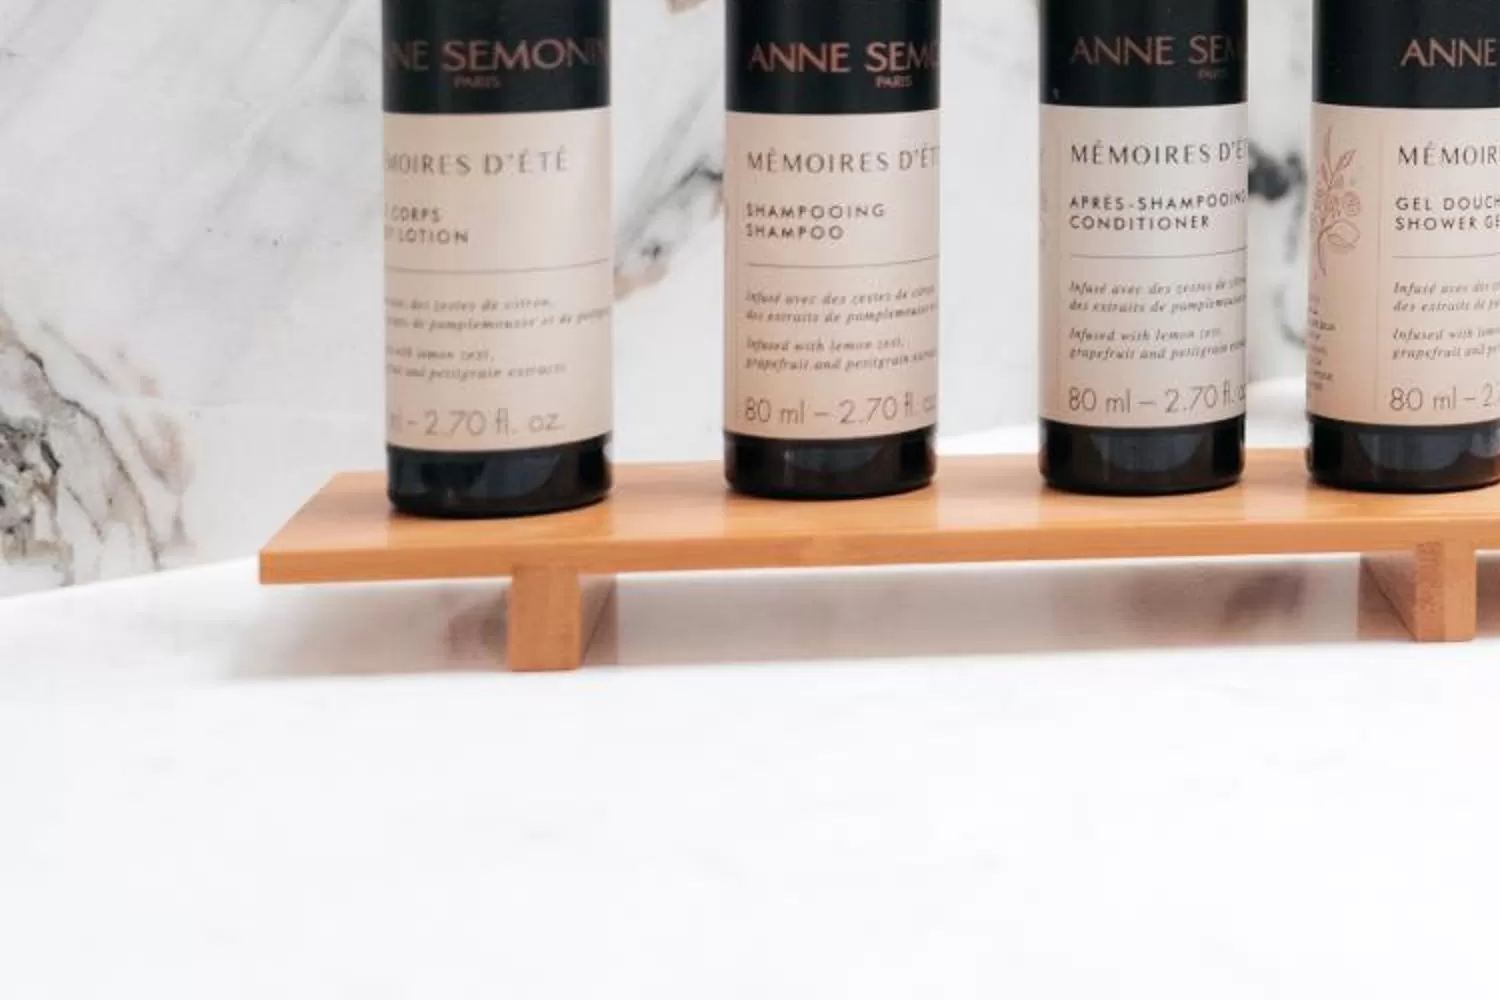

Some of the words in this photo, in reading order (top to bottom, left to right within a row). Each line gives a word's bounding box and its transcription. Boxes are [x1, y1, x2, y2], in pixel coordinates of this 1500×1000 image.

[748, 41, 850, 73] ANNE
[1069, 35, 1176, 66] ANNE
[1400, 37, 1498, 68] ANNE
[454, 75, 500, 89] PARIS
[875, 75, 913, 89] PARIS
[747, 147, 890, 174] MÉMOIRES
[1071, 139, 1211, 166] MÉMOIRES
[746, 203, 886, 219] SHAMPOOING
[1395, 196, 1433, 212] GEL
[390, 205, 441, 222] CORPS
[1068, 215, 1210, 231] CONDITIONER
[1395, 216, 1480, 231] SHOWER
[398, 227, 469, 245] LOTION
[746, 224, 845, 241] SHAMPOO
[1392, 299, 1416, 313] des
[1120, 327, 1151, 342] with
[1392, 326, 1443, 345] Infused
[1139, 346, 1167, 360] and
[1391, 345, 1461, 361] grapefruit
[814, 356, 842, 370] and
[1068, 385, 1097, 412] 80
[1105, 388, 1132, 414] ml
[1164, 383, 1217, 413] 2.70
[1389, 386, 1424, 412] 80
[1432, 384, 1457, 410] ml
[744, 395, 772, 424] 80
[779, 400, 805, 425] ml
[838, 395, 898, 425] 2.70
